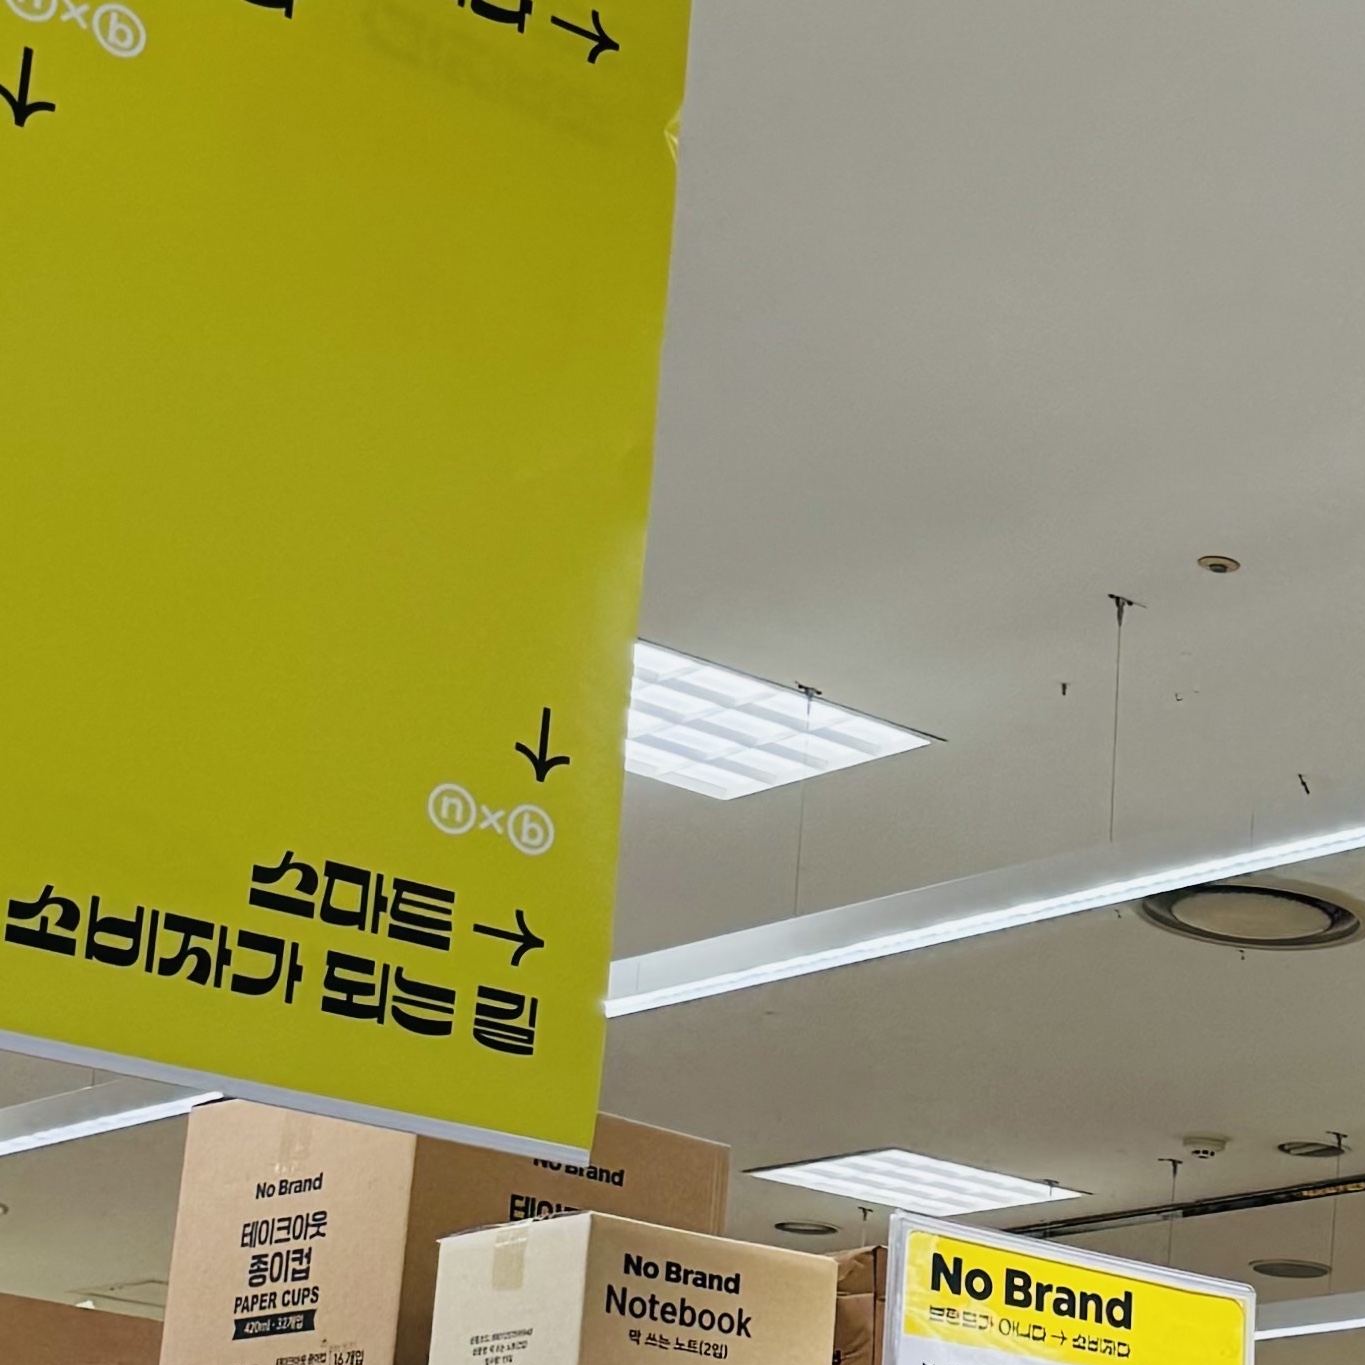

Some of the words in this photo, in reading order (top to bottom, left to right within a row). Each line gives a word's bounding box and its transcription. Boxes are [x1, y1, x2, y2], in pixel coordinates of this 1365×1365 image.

[249, 851, 455, 951] 스마트
[4, 885, 302, 1004] 소비자가
[321, 950, 456, 1037] 되는
[472, 986, 539, 1055] 길
[256, 1181, 276, 1199] No
[279, 1173, 323, 1195] Brand
[240, 1210, 327, 1248] 테이크아웃
[248, 1247, 312, 1287] 종이컵
[623, 1253, 659, 1279] No
[665, 1261, 741, 1294] Brand
[233, 1290, 277, 1313] PAPER
[281, 1286, 319, 1307] CUPS
[605, 1284, 752, 1338] Notebook
[931, 1252, 993, 1302] No
[1005, 1268, 1132, 1330] Brand
[628, 1329, 641, 1345] 막
[645, 1333, 670, 1350] 쓰는
[998, 1318, 1046, 1342] 아니다
